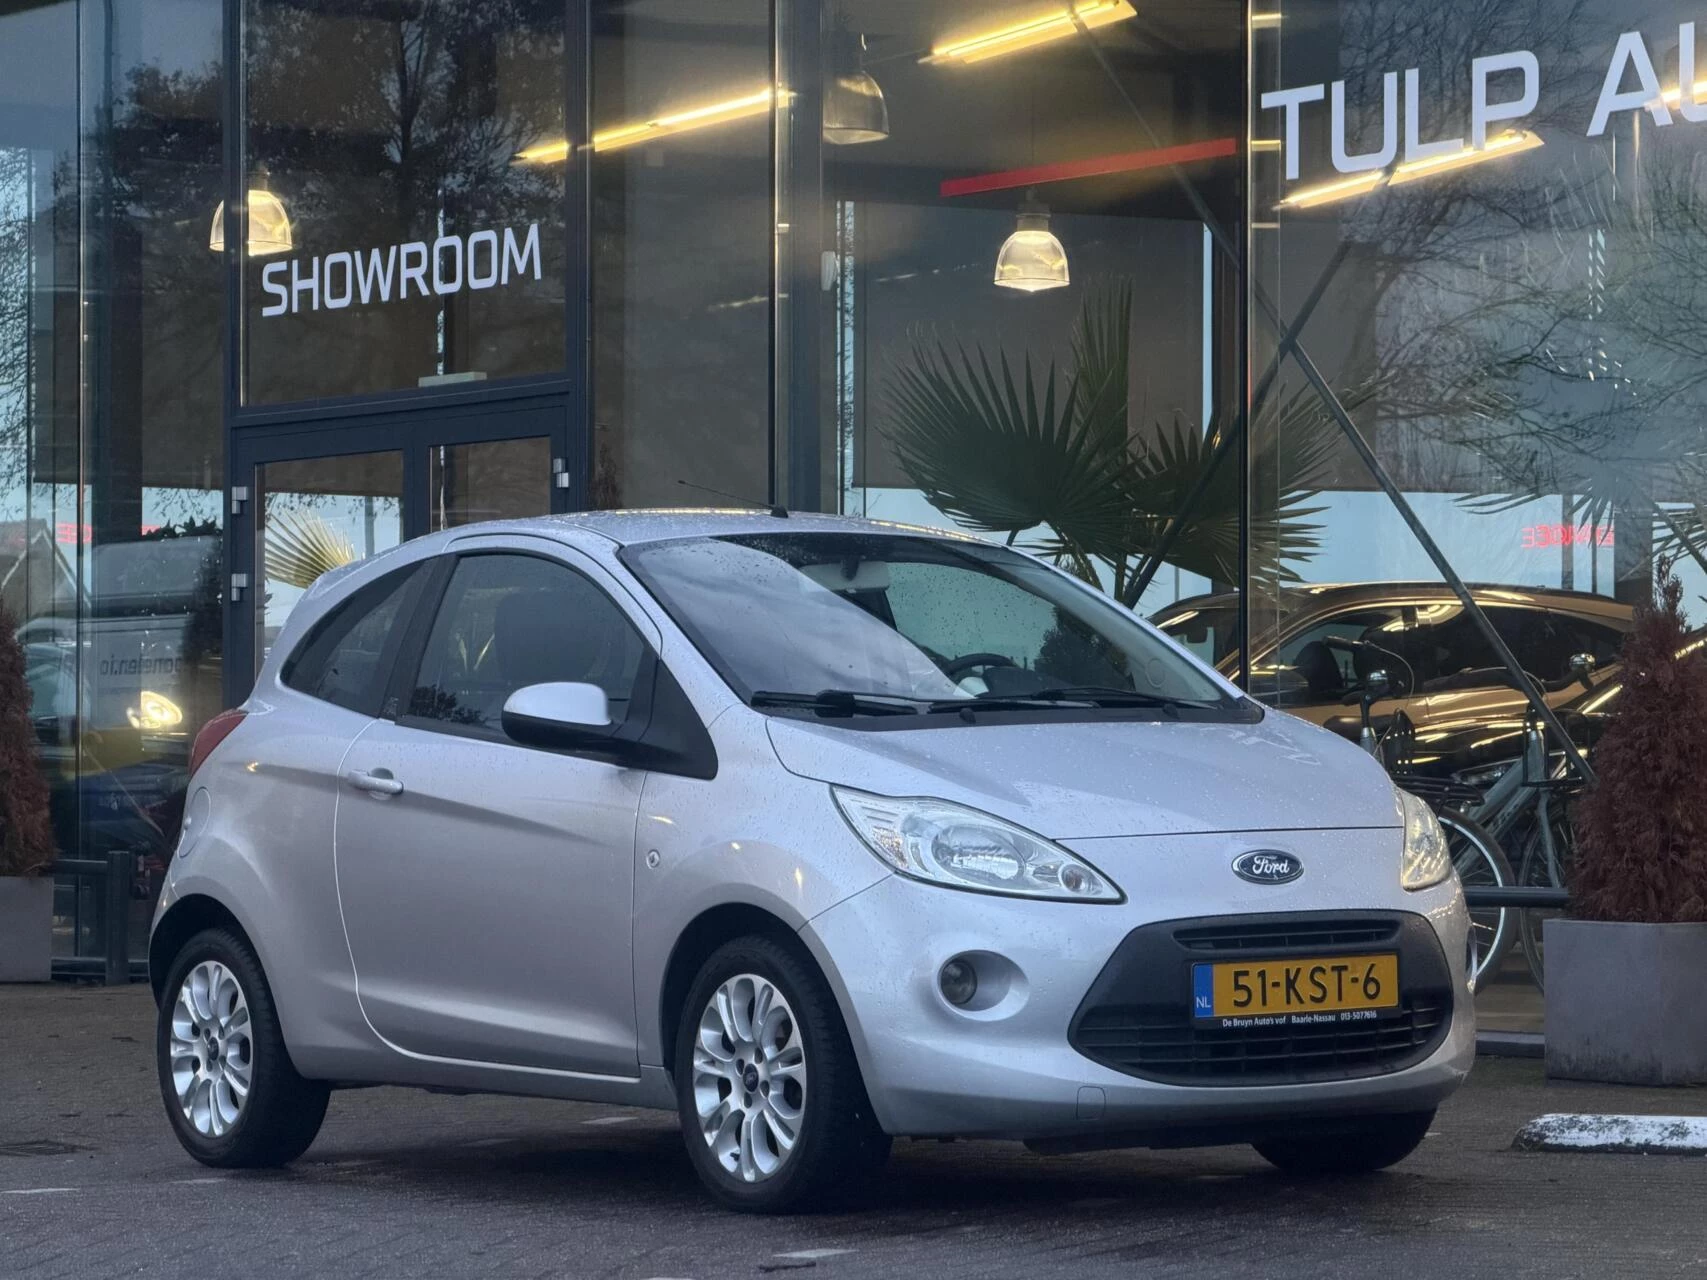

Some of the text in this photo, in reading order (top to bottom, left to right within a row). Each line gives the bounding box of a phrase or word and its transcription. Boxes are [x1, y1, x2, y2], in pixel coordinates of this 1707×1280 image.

[1261, 50, 1539, 181] TULP
[262, 223, 542, 317] SHOWROOM
[1252, 855, 1290, 875] Ford
[1233, 963, 1381, 1008] 51-KST-6
[1196, 996, 1211, 1009] NL
[1223, 1019, 1232, 1027] De
[1233, 1018, 1253, 1028] Bruyn
[1254, 1016, 1274, 1027] Auto's
[1275, 1015, 1287, 1025] vof
[1291, 1014, 1336, 1025] Baarle-Nassau
